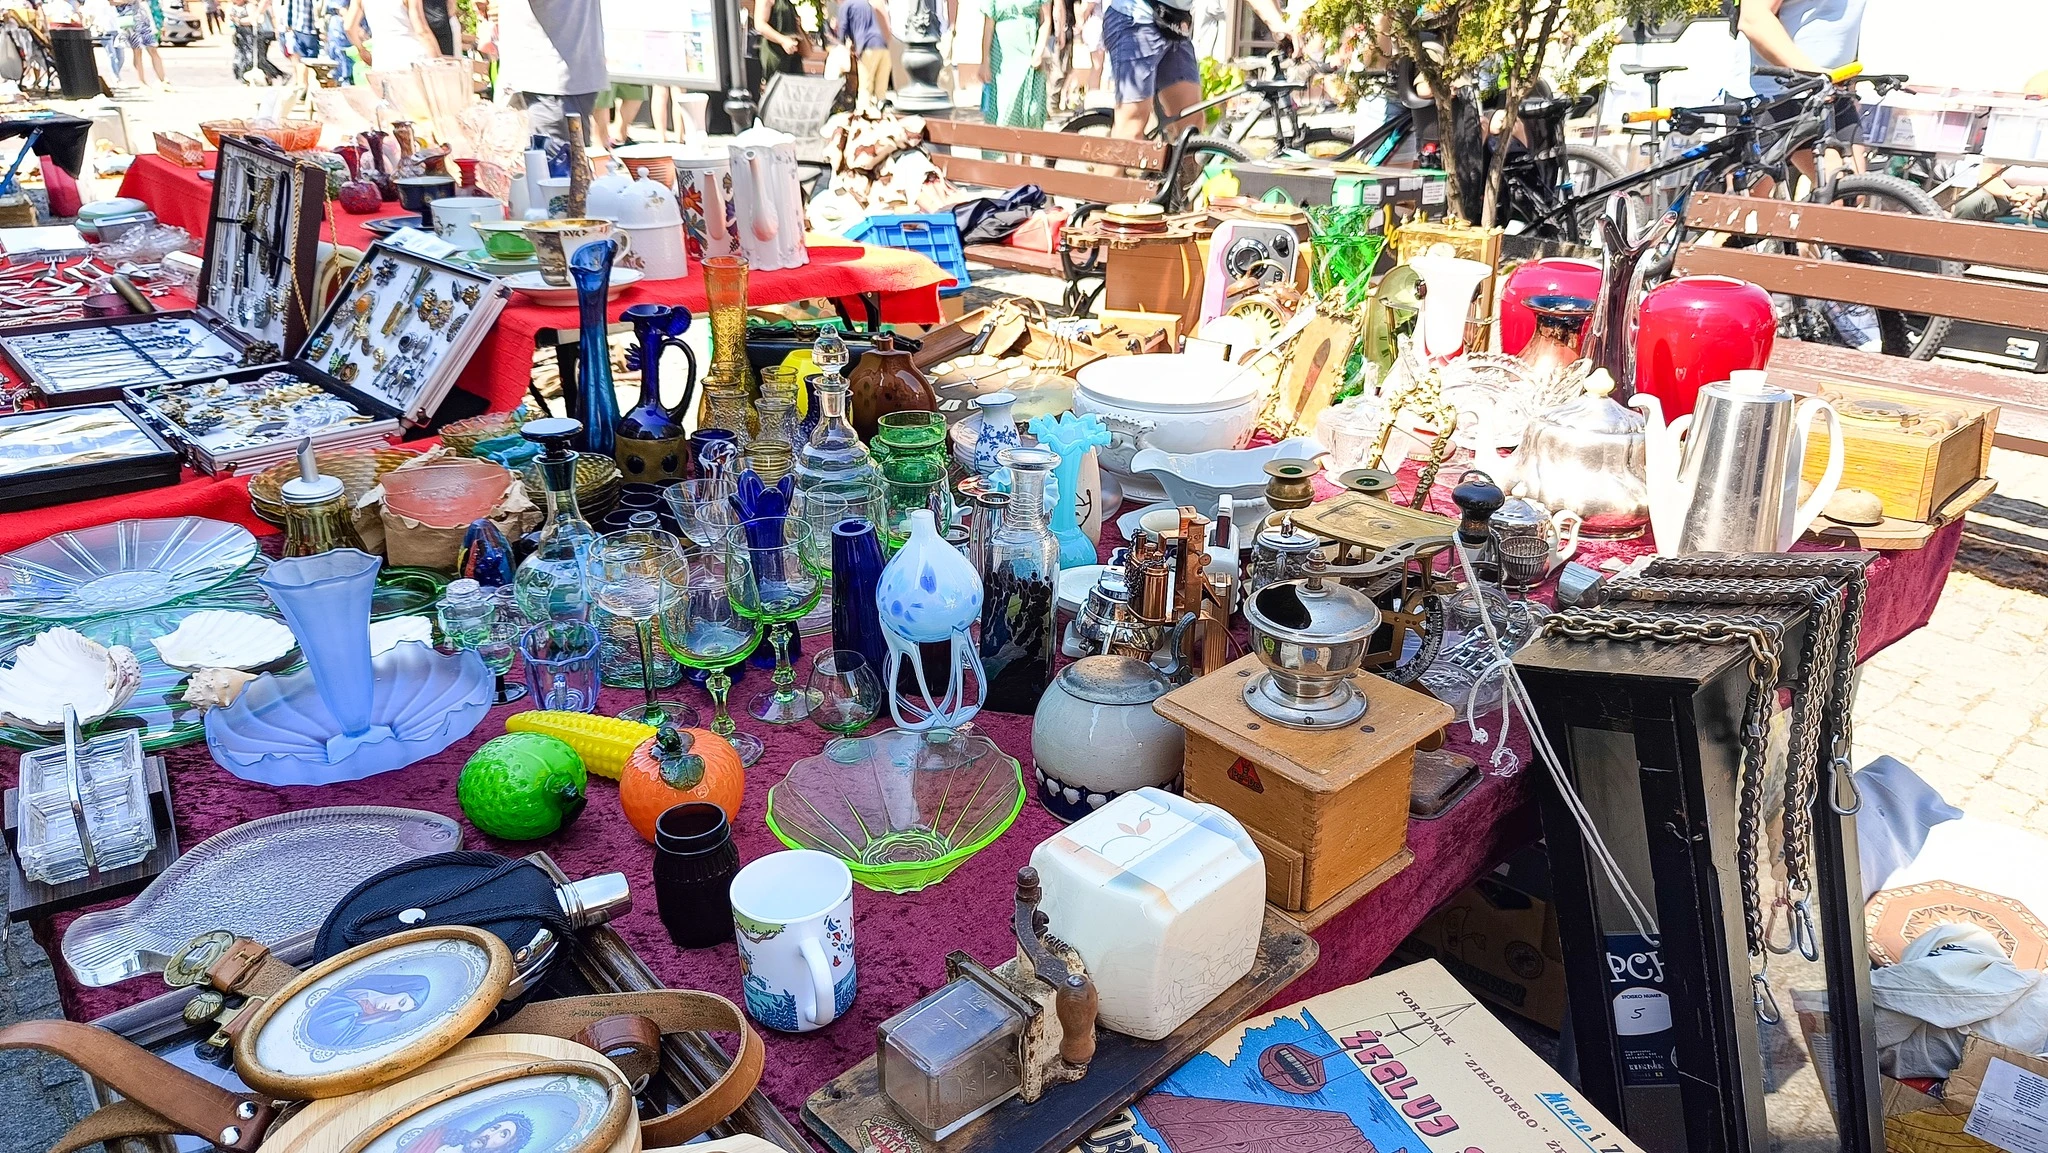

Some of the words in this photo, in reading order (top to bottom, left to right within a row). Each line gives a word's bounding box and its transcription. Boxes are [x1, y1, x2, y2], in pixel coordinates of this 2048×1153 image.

[1396, 989, 1456, 1047] PORADNIK
[1630, 1007, 1646, 1020] 5
[1340, 1030, 1460, 1137] ŻEGLUJ
[1540, 1091, 1592, 1132] Morze
[1588, 1132, 1606, 1143] i
